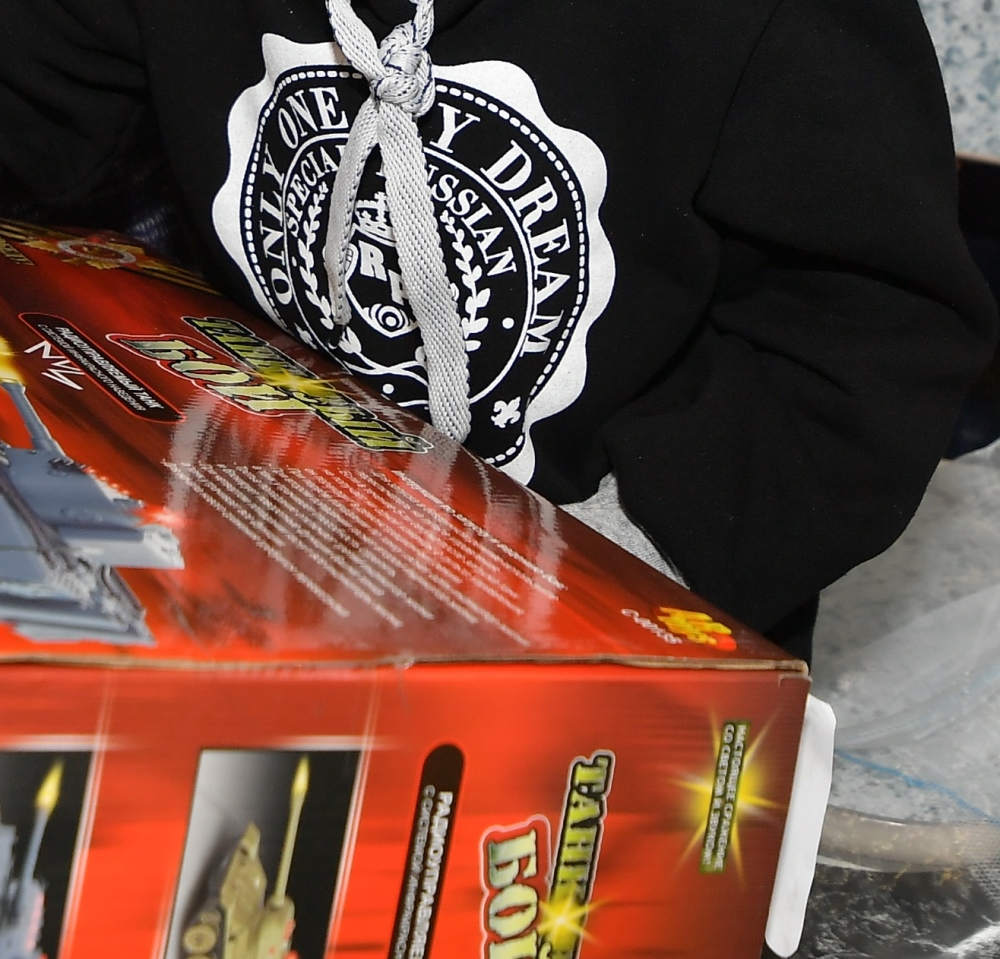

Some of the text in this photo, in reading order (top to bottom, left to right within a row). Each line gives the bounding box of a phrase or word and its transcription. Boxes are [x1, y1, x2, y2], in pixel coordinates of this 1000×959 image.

[260, 87, 571, 357] ONLY ONE Y DREAM
[120, 339, 320, 412] БОЙ
[193, 319, 424, 450] ТАНКВЫЙ
[715, 744, 731, 797] СВЕТОМ
[724, 724, 735, 744] СО
